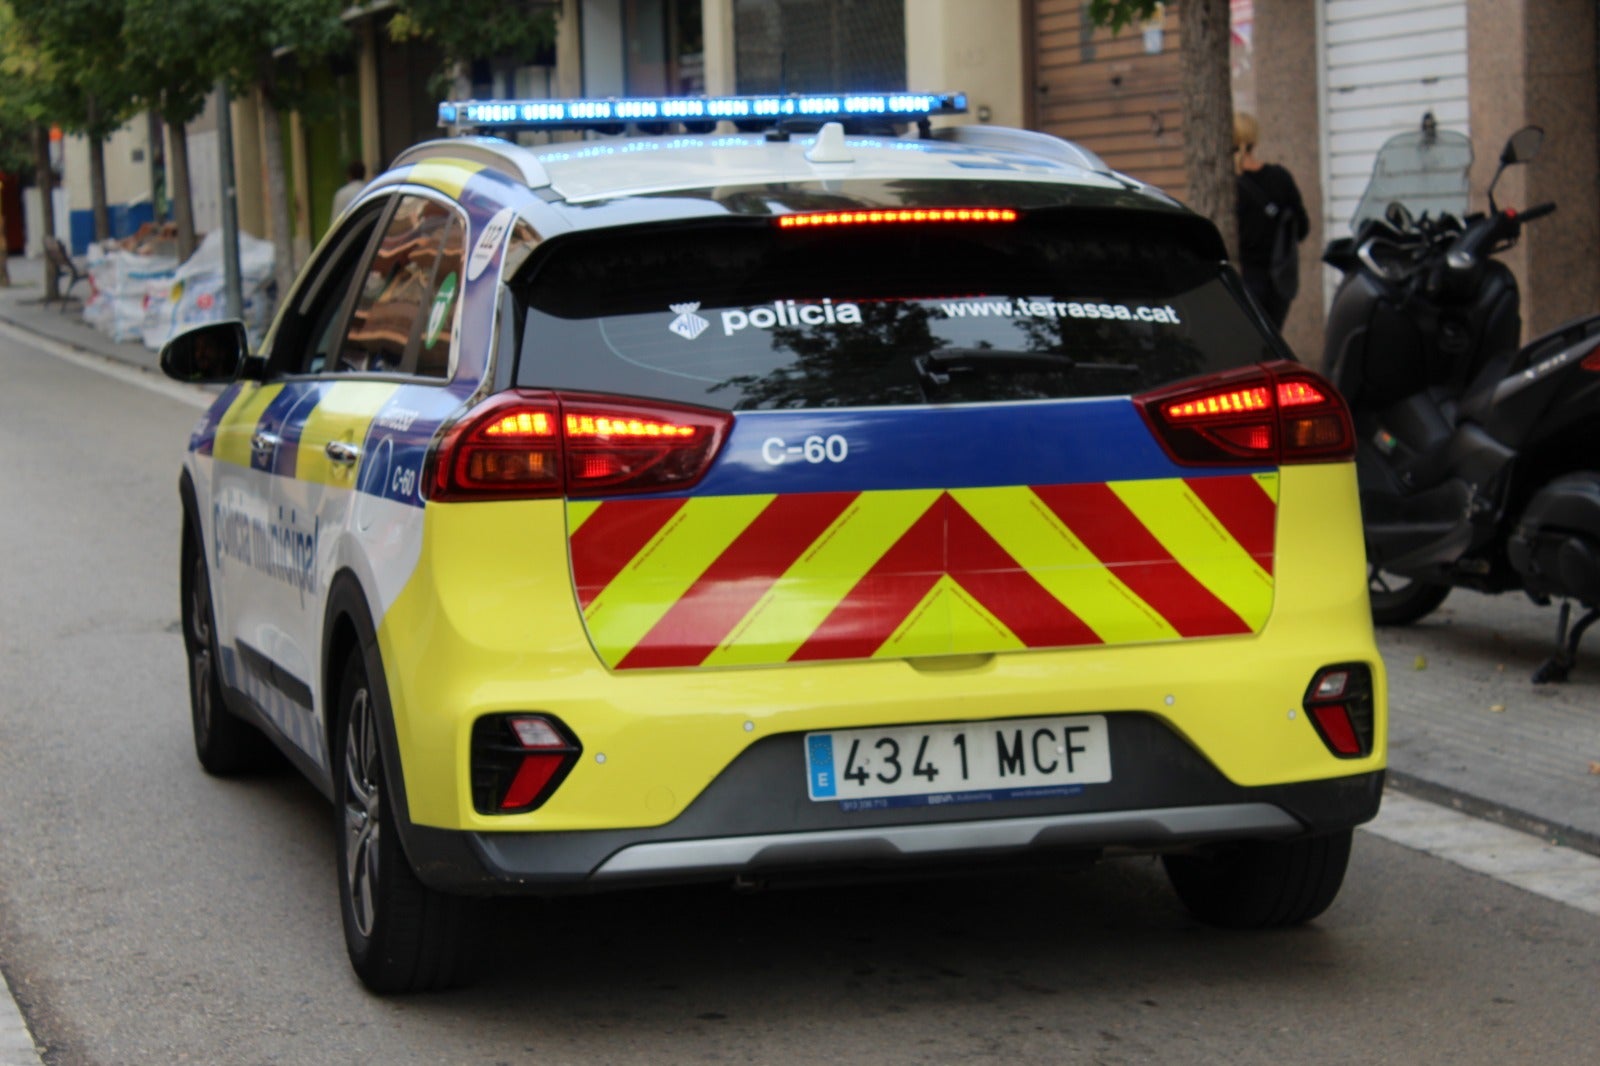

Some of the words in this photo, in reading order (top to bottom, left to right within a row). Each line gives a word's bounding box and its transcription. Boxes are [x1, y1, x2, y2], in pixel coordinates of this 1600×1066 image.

[721, 298, 863, 336] policia
[942, 298, 1181, 324] www.terrassa.cat
[762, 434, 849, 465] C-60
[392, 465, 416, 497] C-60
[843, 733, 969, 786] 4341
[996, 725, 1090, 778] MCF
[817, 773, 829, 786] E
